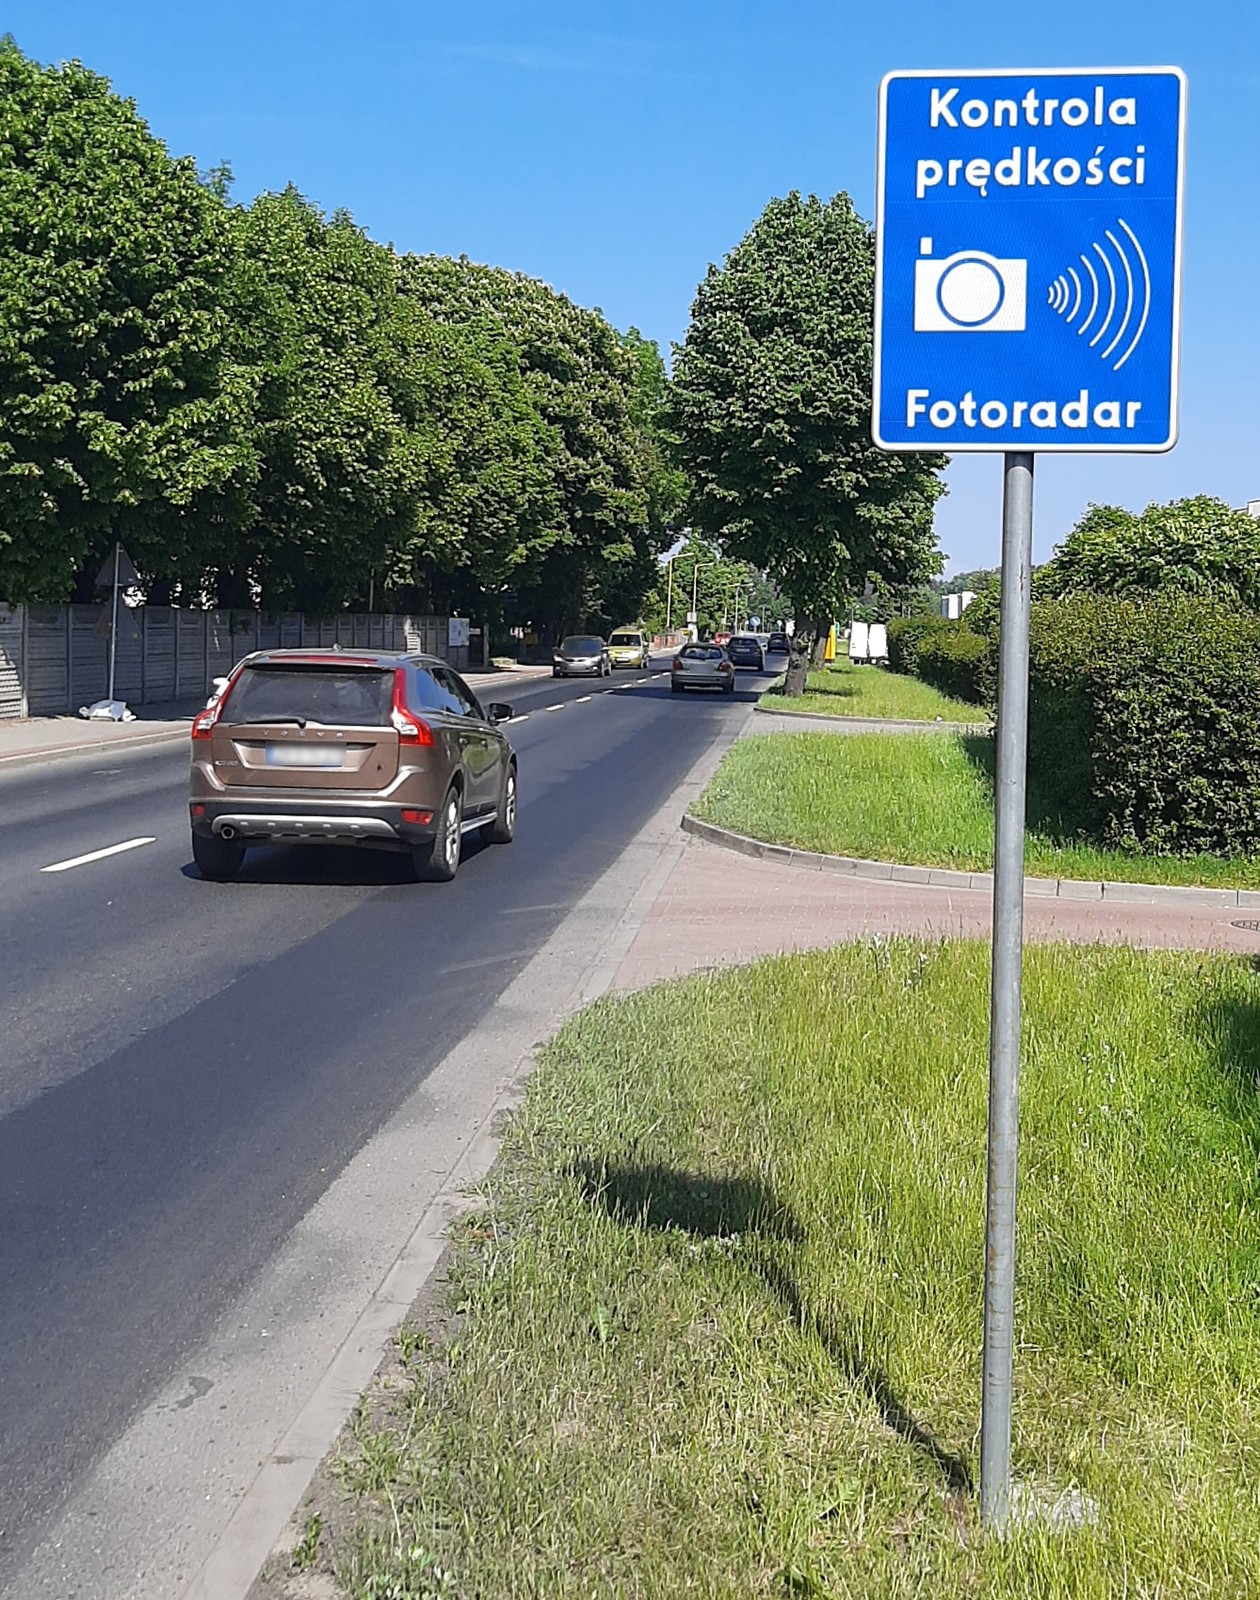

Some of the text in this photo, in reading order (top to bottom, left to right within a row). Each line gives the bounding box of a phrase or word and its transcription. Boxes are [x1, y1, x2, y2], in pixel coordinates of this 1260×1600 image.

[930, 86, 1137, 128] Kontrola
[916, 145, 1146, 199] prędkości
[906, 389, 1142, 430] Fotoradar
